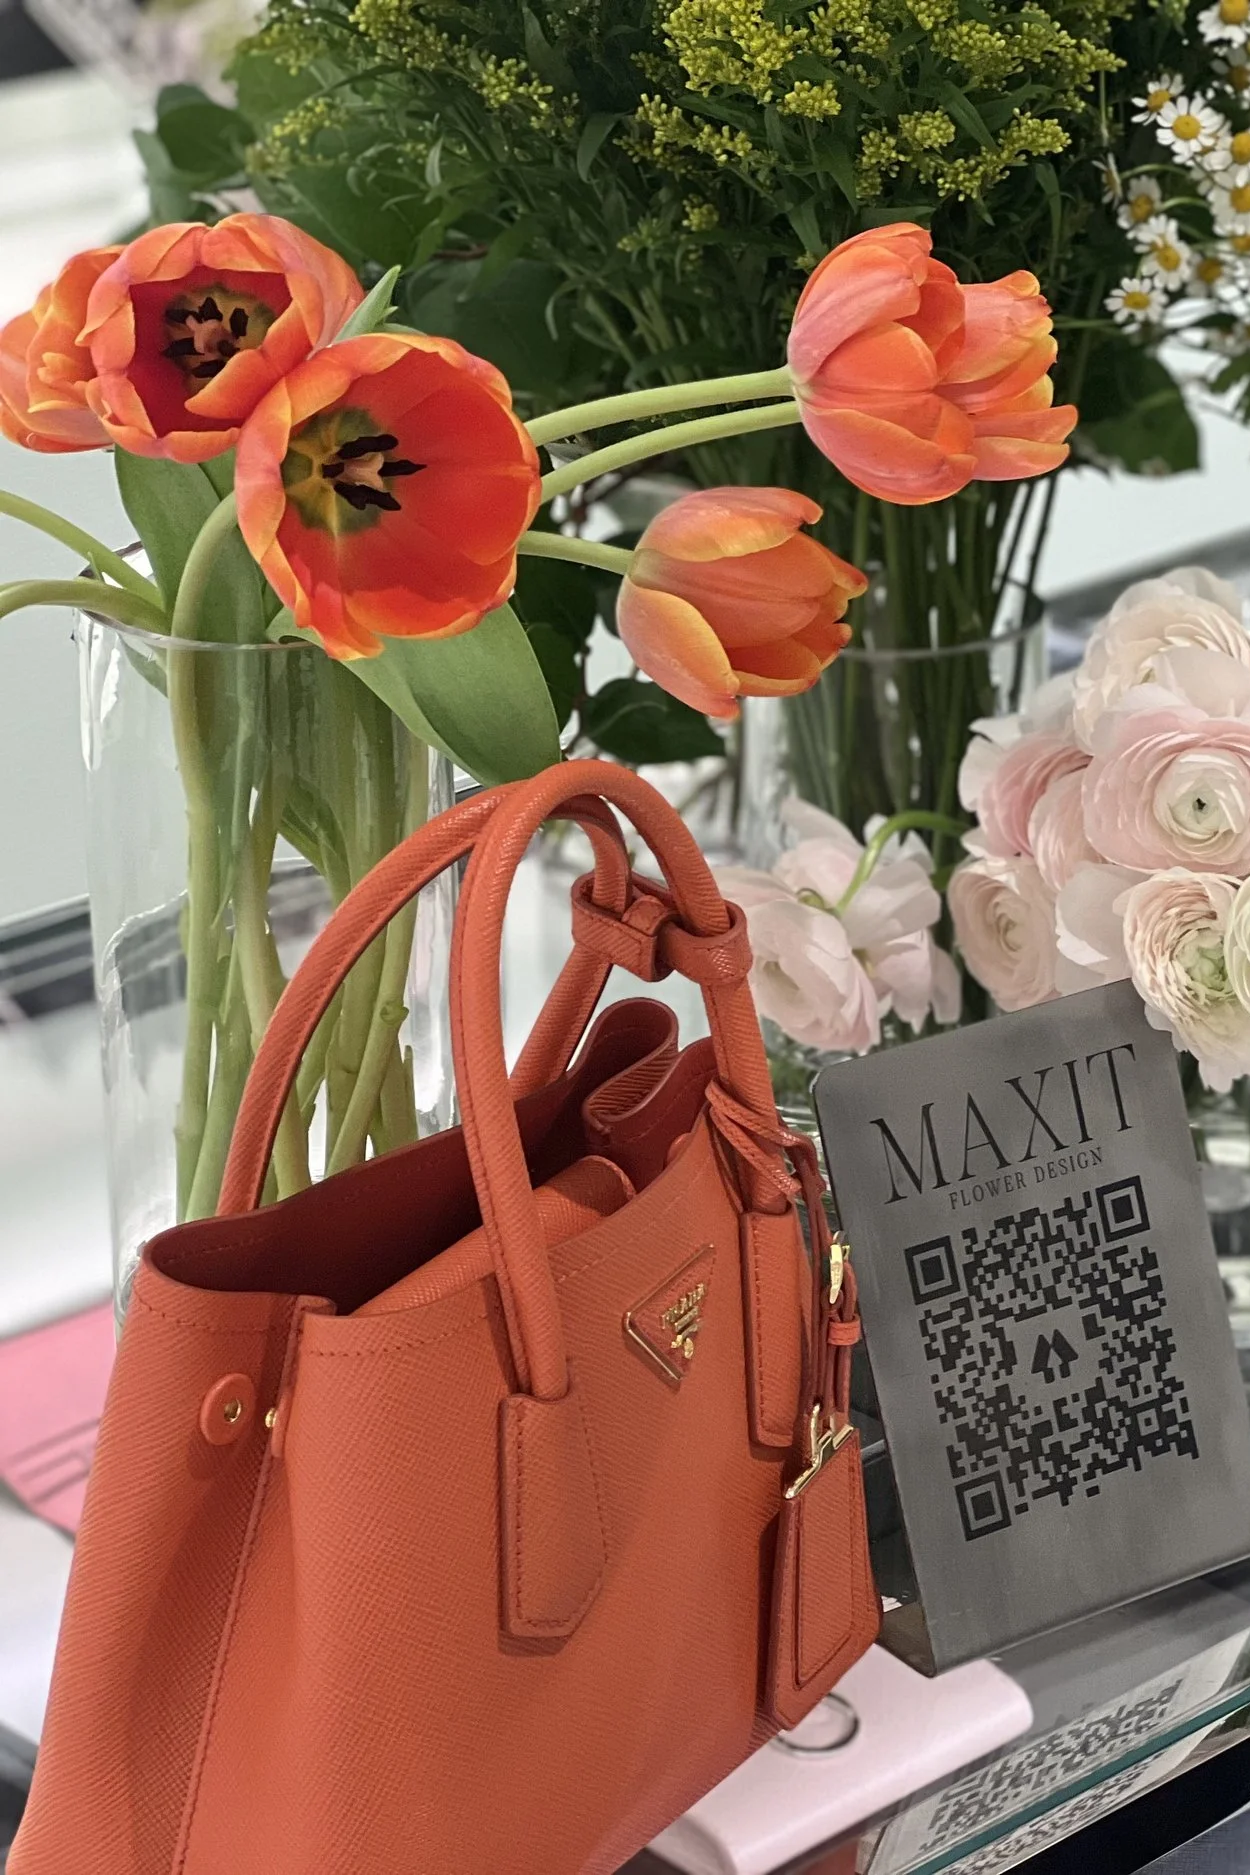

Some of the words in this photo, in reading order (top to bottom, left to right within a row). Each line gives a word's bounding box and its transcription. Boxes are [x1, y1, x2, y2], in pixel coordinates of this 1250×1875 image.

[870, 1043, 1136, 1204] MAXIT
[949, 1170, 1027, 1209] FLOWER
[1033, 1146, 1104, 1184] DESIGN
